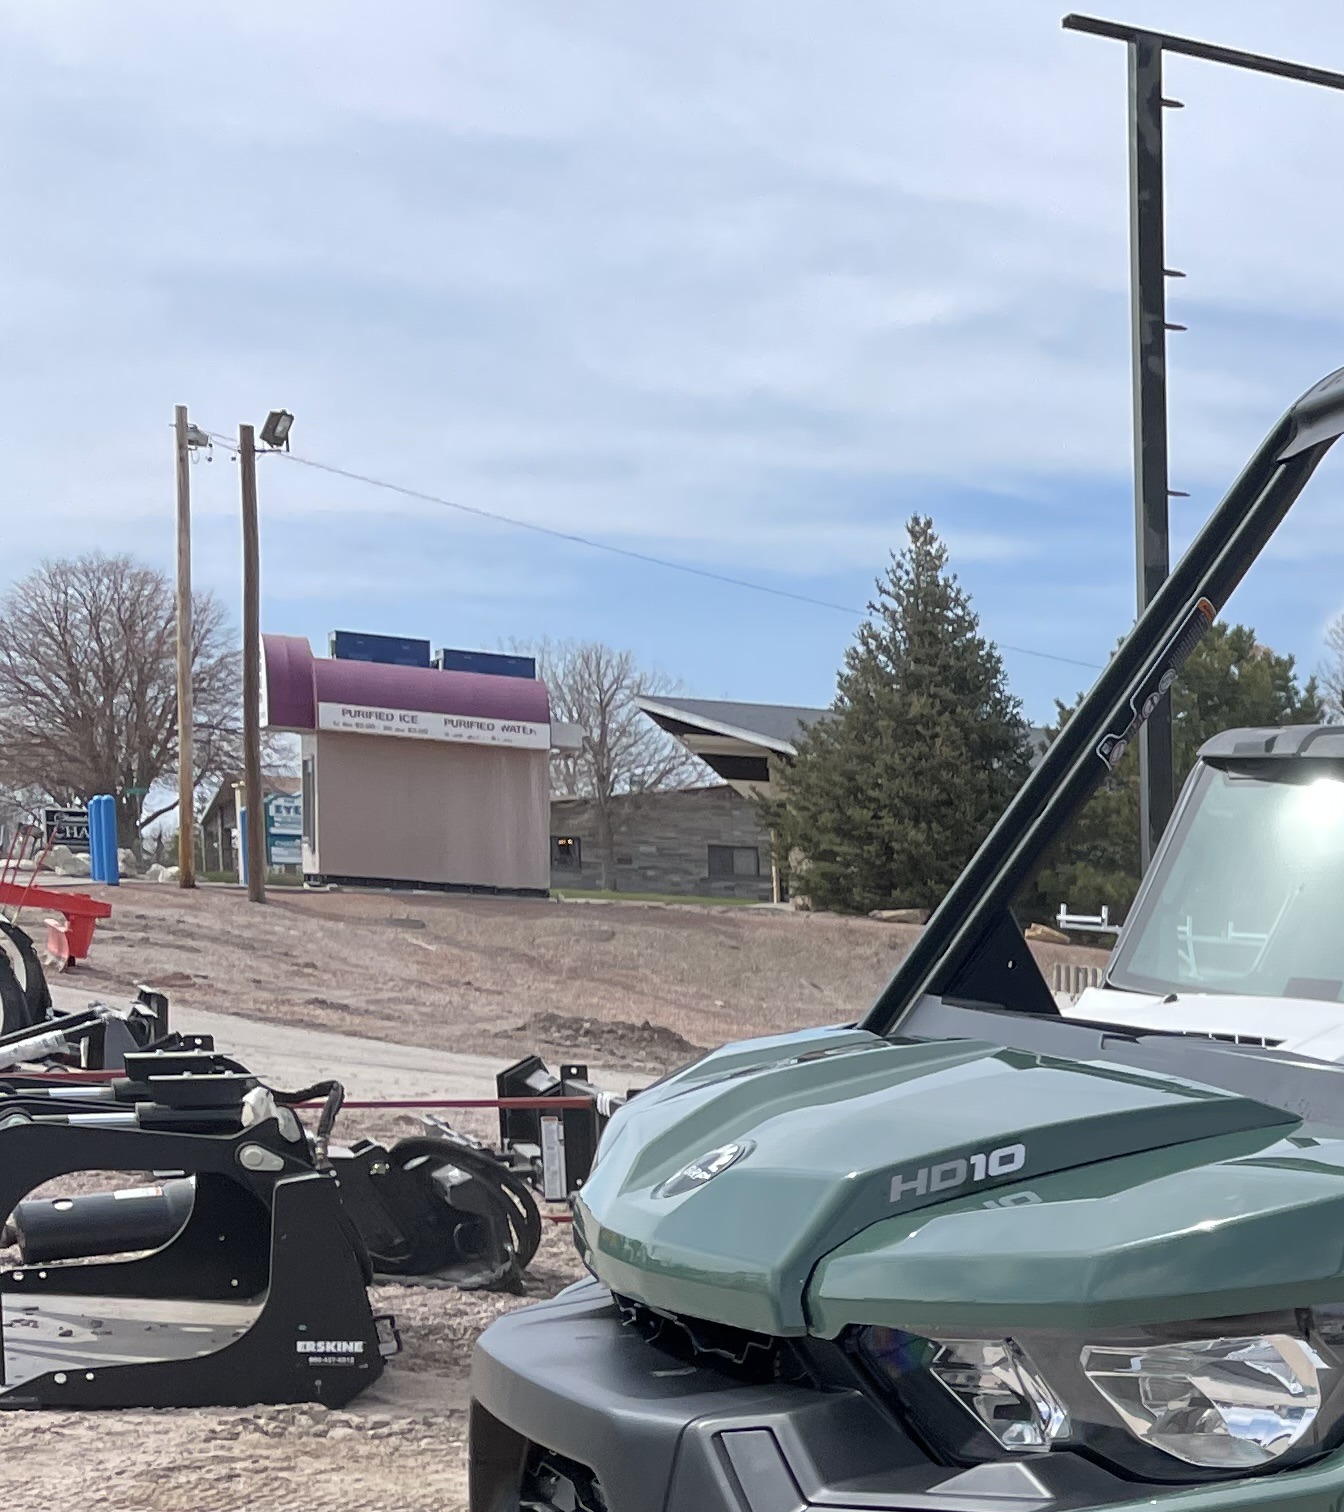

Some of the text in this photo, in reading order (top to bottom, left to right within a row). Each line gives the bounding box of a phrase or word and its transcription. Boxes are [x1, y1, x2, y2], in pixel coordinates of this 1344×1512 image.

[341, 707, 419, 725] PURIFIED ICE
[443, 718, 496, 732] PURIFIED
[889, 1143, 1027, 1203] HD10
[296, 1340, 364, 1353] ERSKINE
